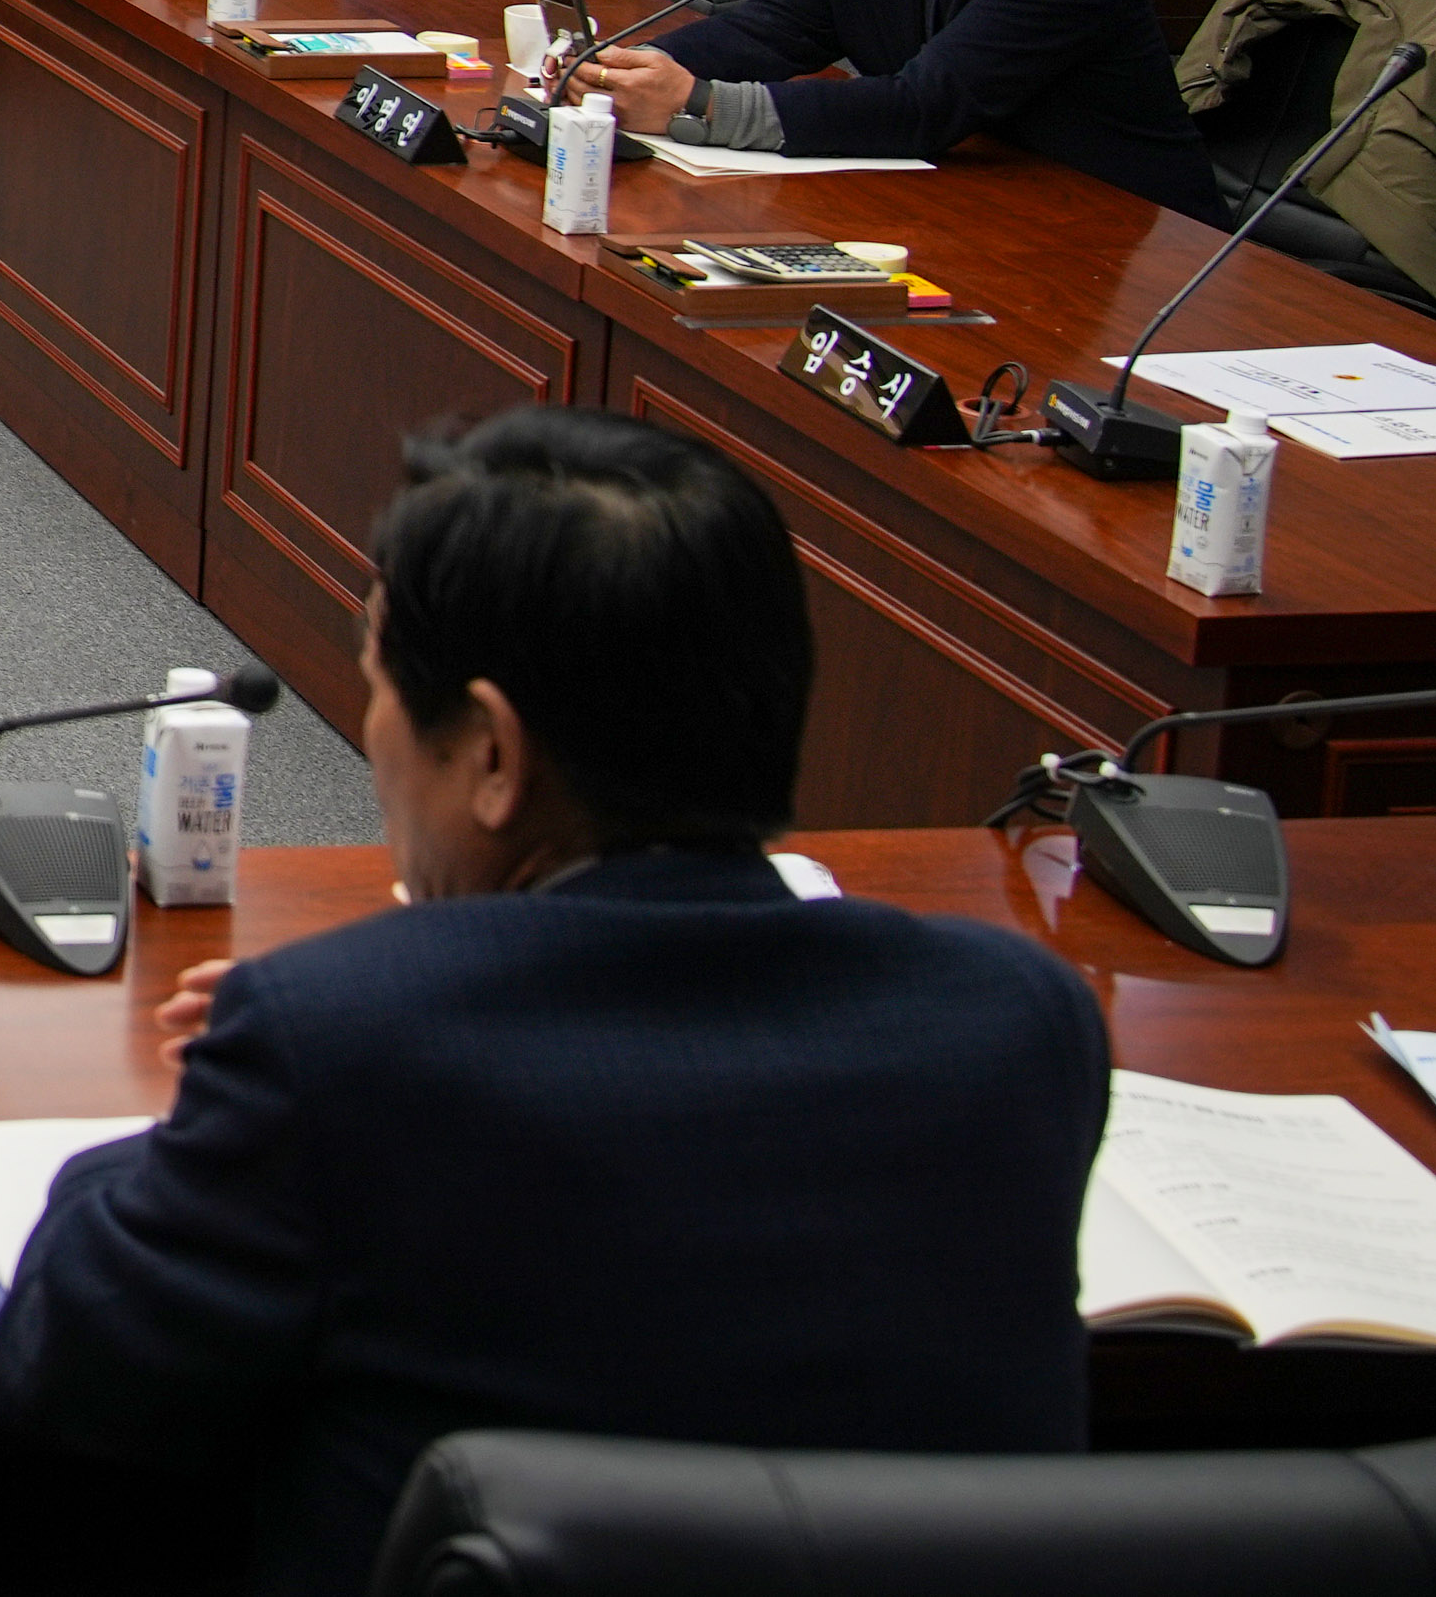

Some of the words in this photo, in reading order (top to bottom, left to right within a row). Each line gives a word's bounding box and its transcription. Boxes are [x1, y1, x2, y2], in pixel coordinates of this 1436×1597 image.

[356, 84, 424, 146] 이명연
[803, 330, 912, 419] 임승식
[178, 811, 232, 833] WATER
